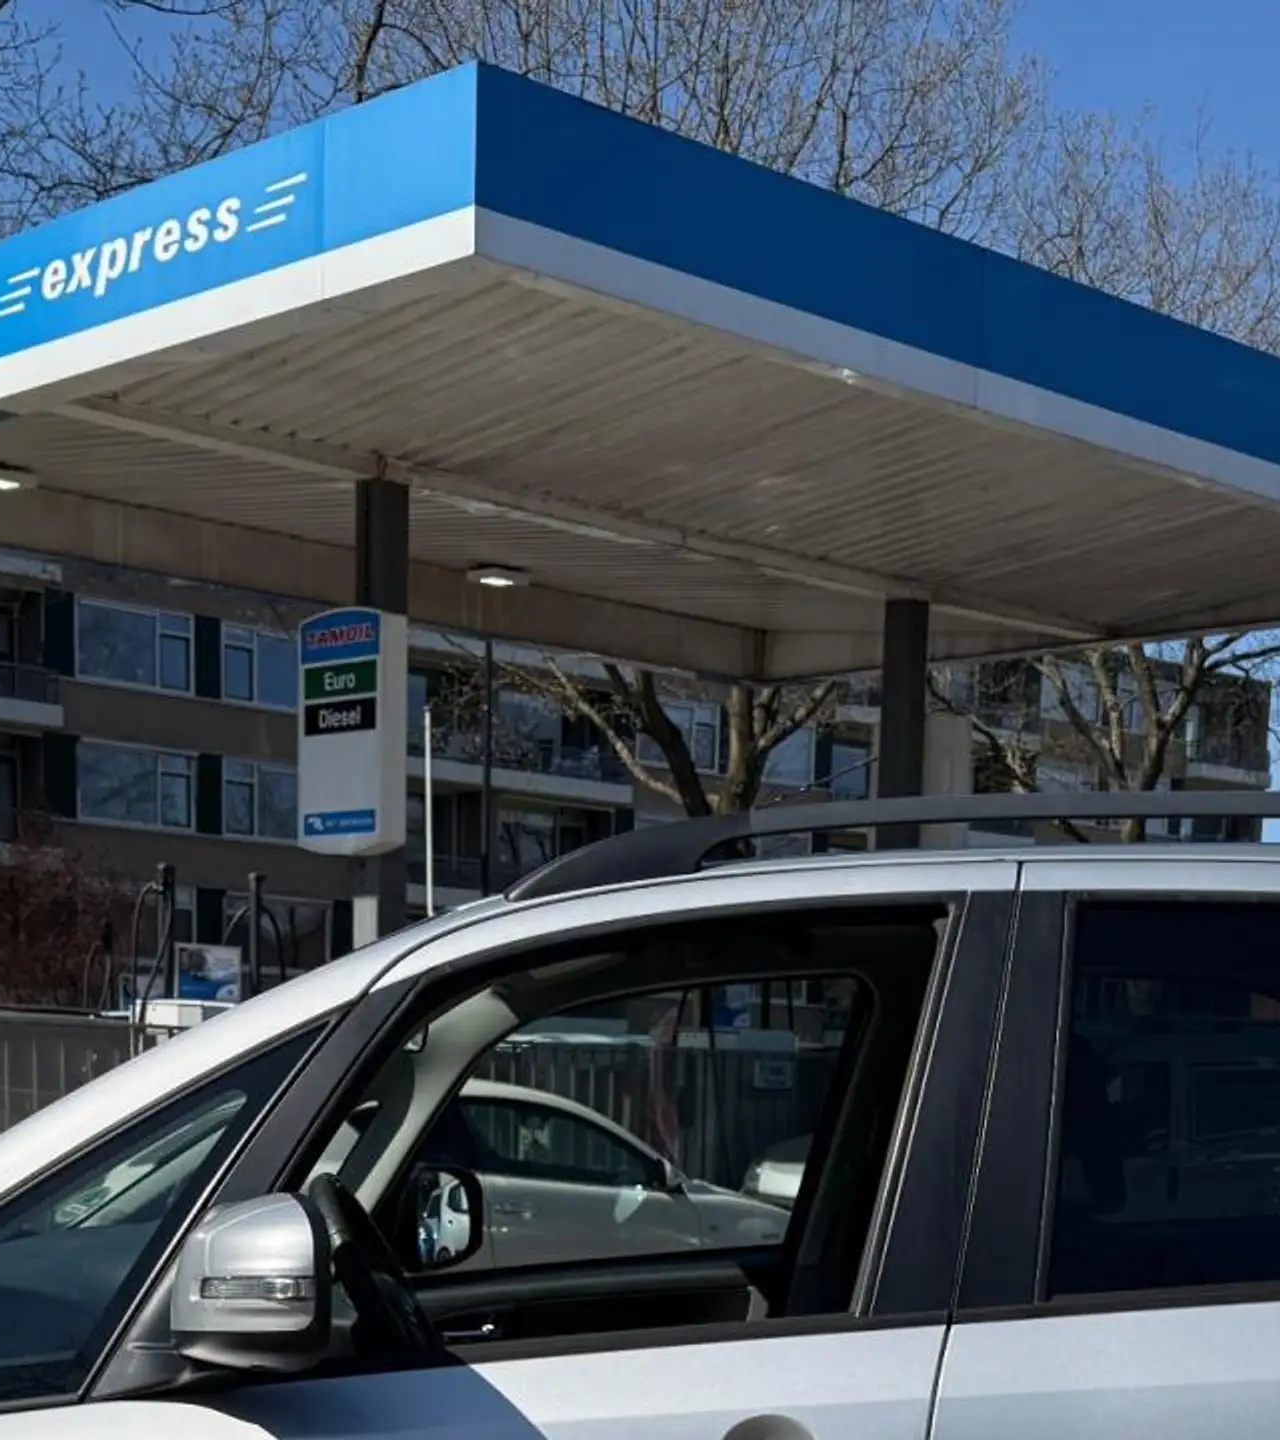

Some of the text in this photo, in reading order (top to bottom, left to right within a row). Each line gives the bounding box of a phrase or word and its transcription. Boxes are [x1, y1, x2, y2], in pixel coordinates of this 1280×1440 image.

[40, 195, 241, 300] express
[306, 624, 374, 649] TAMOIL
[323, 672, 356, 692] Euro
[318, 705, 362, 729] Diesel
